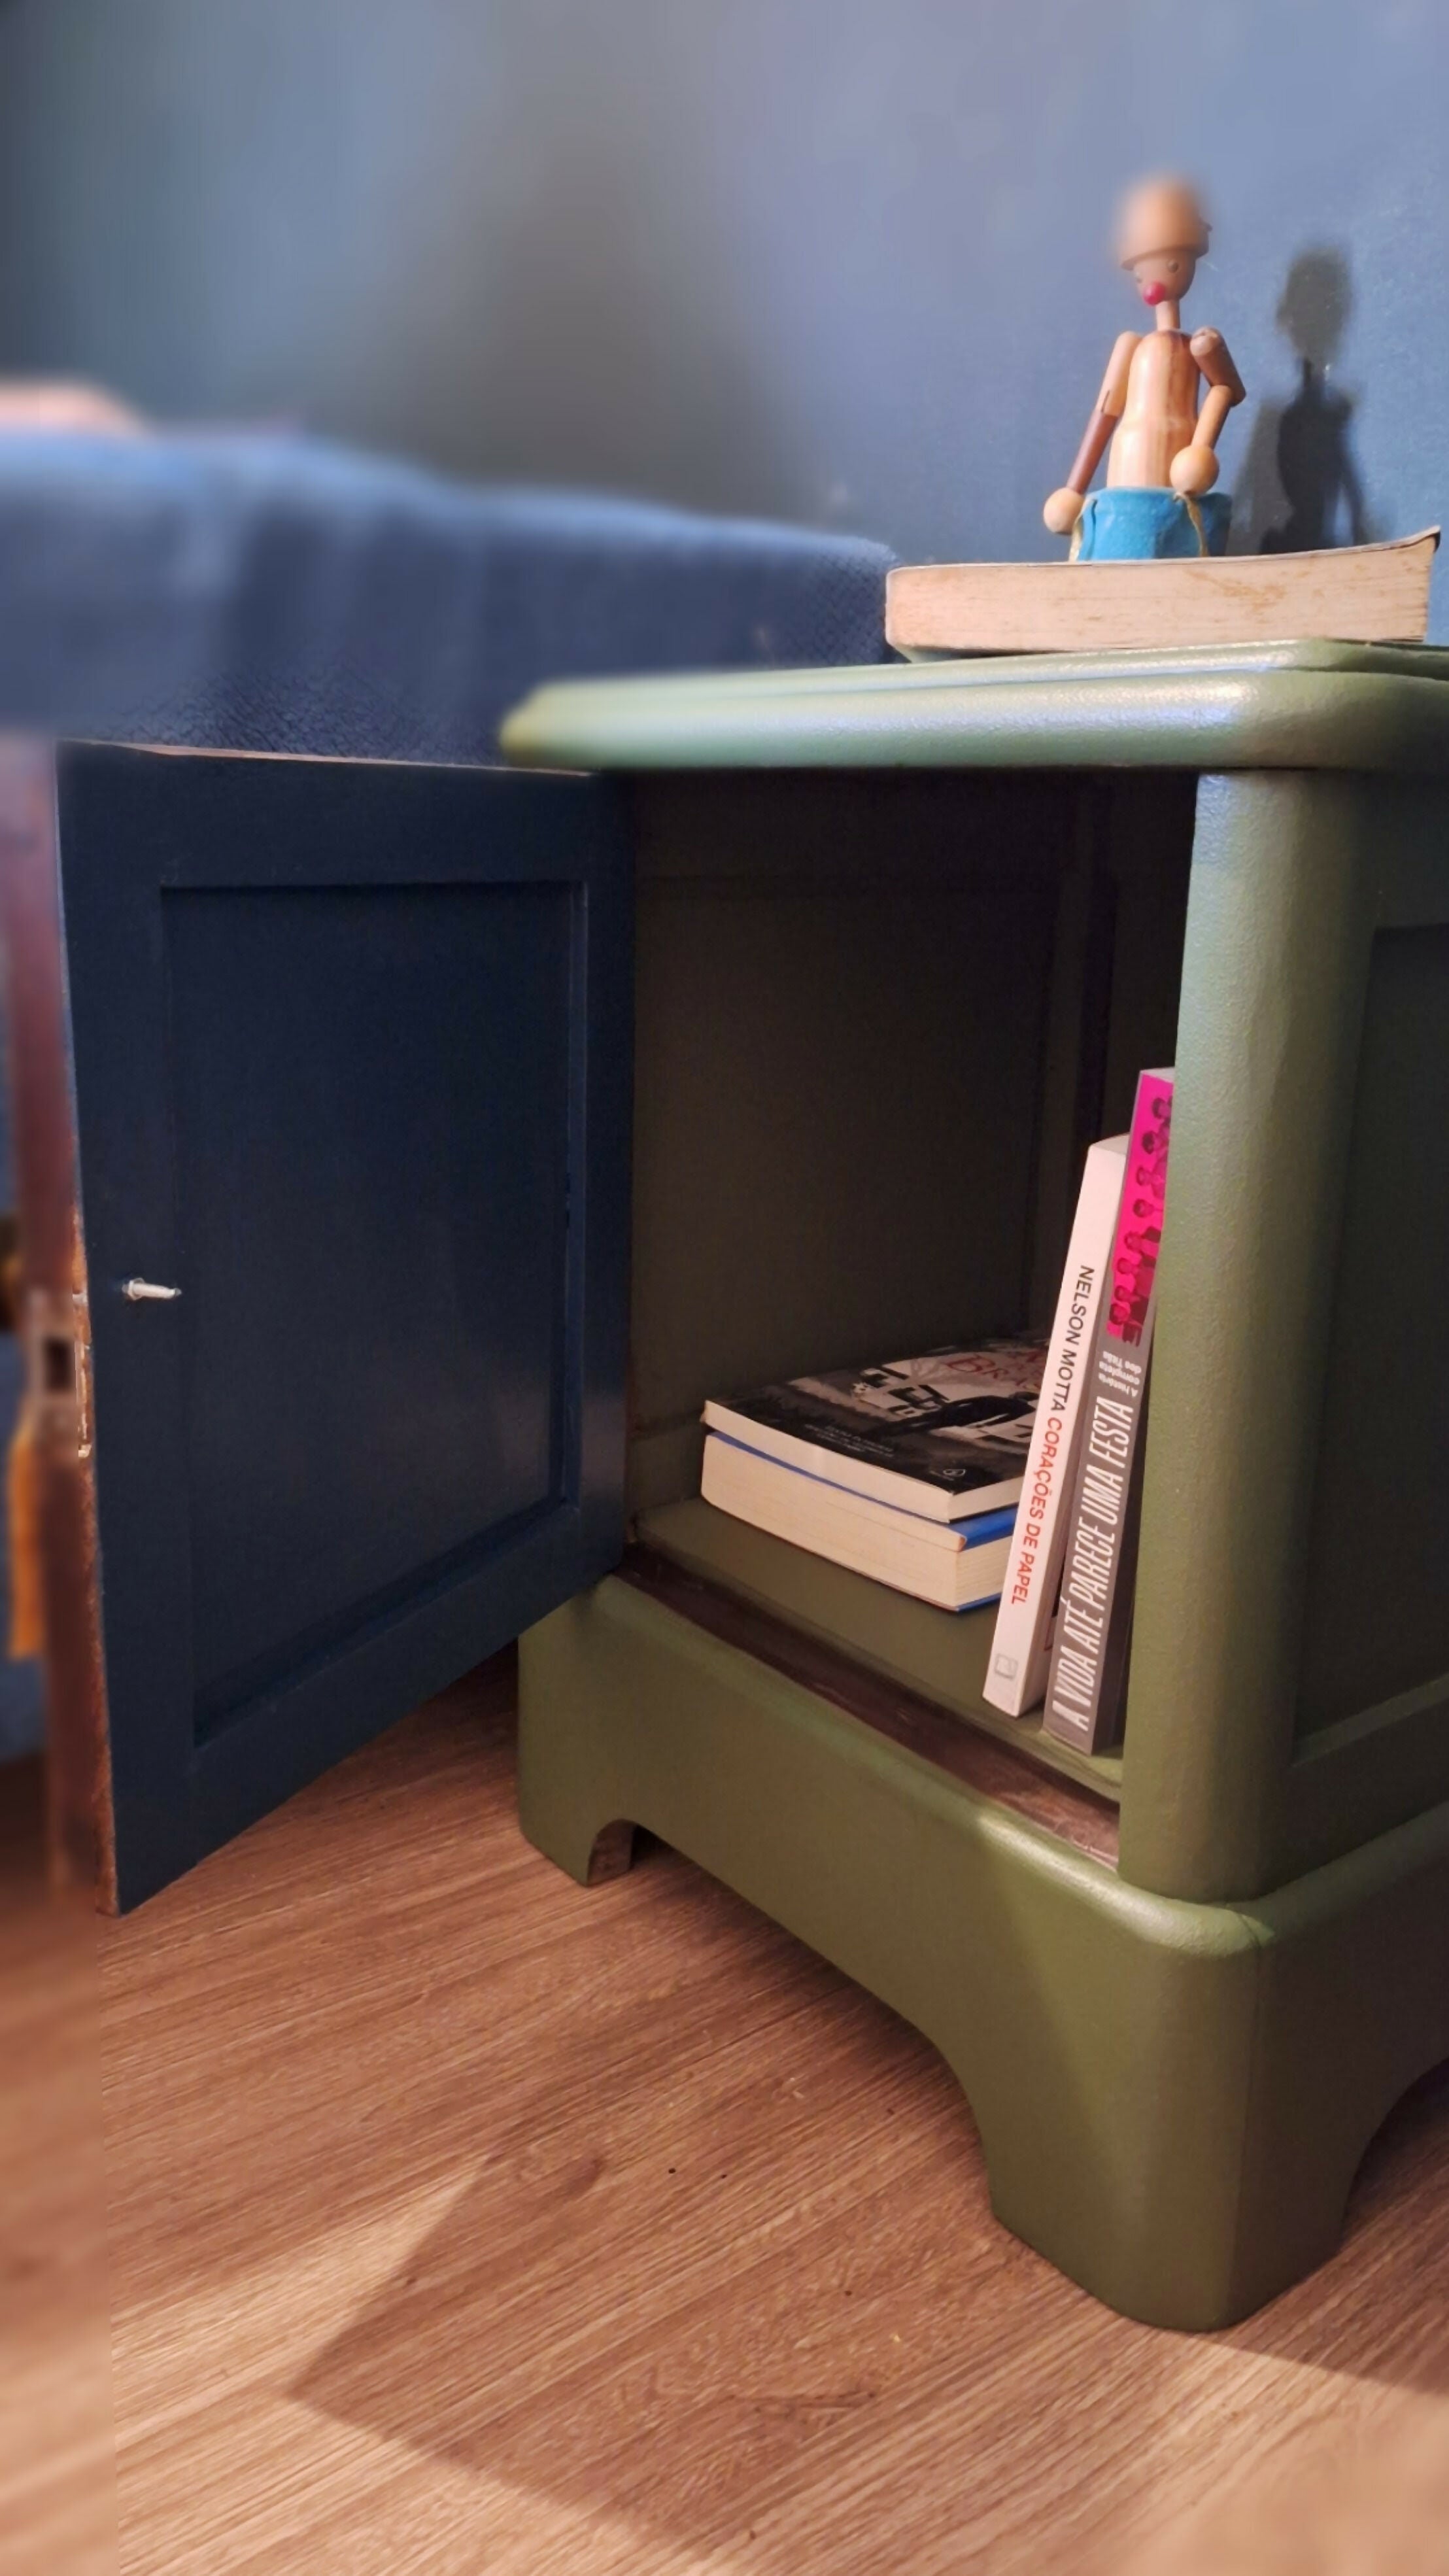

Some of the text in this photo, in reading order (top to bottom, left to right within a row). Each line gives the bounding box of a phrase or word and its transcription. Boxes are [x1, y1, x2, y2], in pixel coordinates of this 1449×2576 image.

[1011, 1265, 1095, 1605] NELSON MOTTA CORAÇÕES DE PAPEL
[1052, 1396, 1134, 1732] A VIDA ATÉ PARECE UMA FESTA
